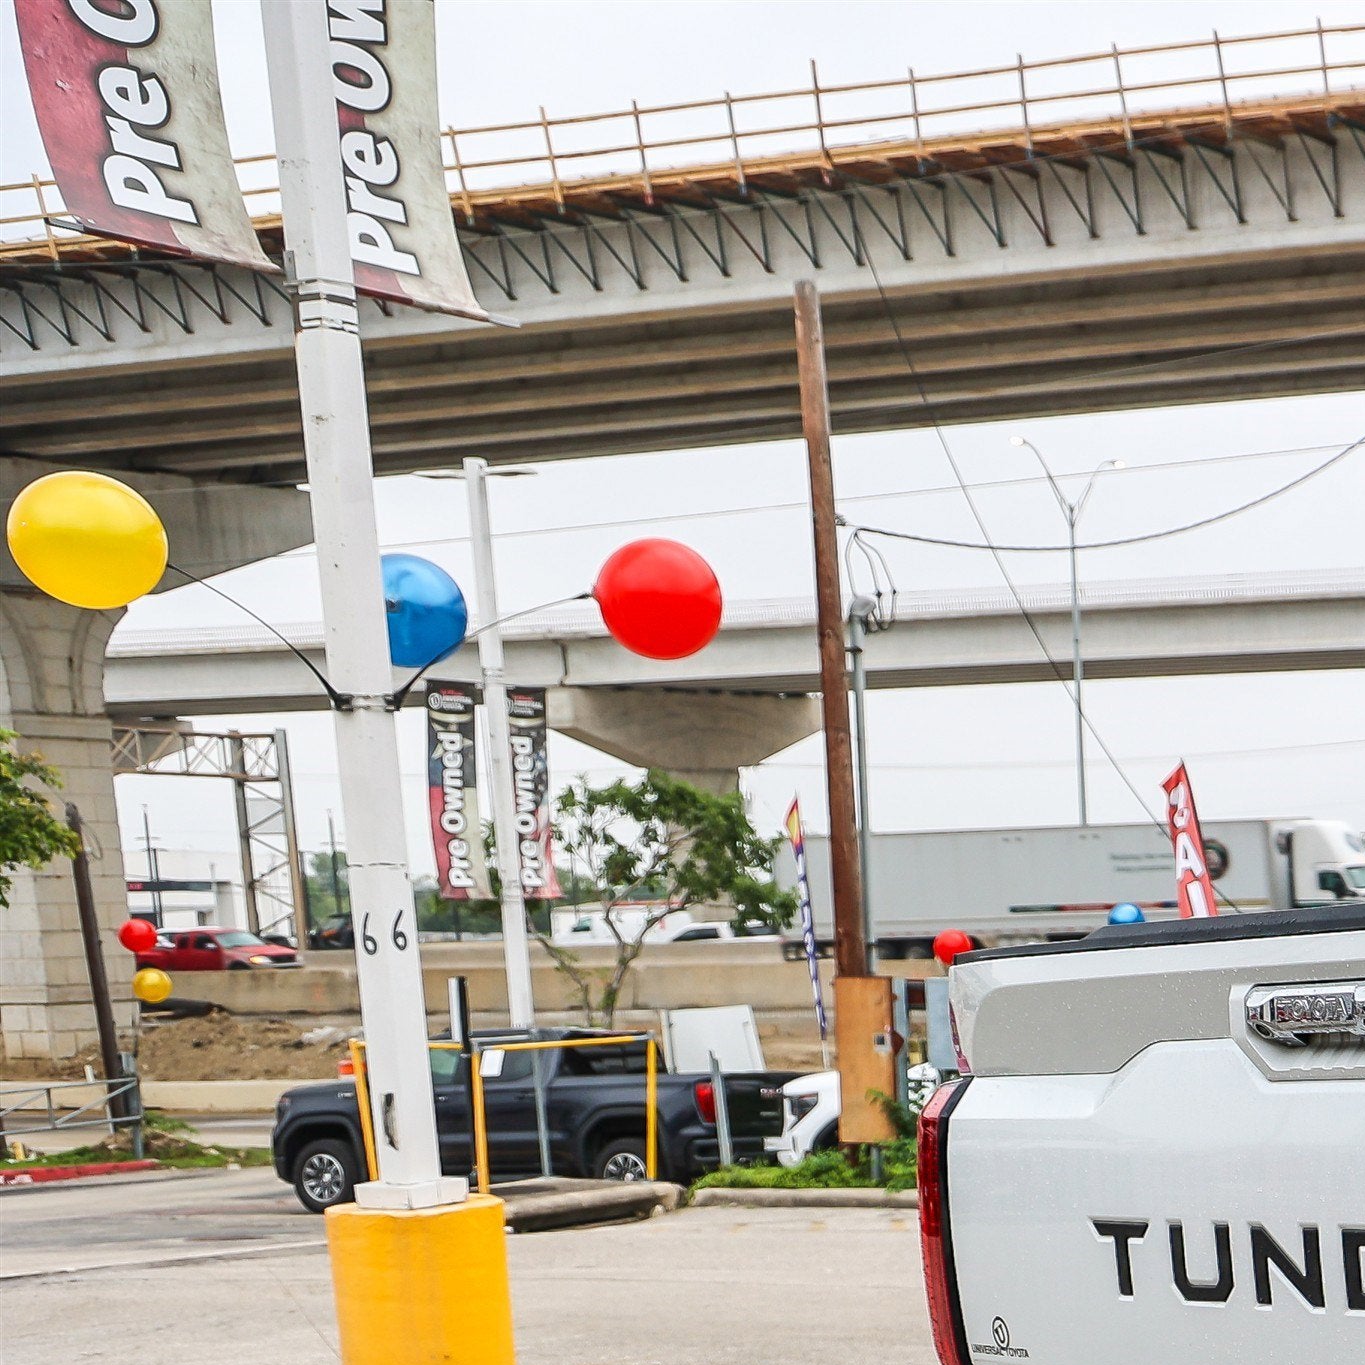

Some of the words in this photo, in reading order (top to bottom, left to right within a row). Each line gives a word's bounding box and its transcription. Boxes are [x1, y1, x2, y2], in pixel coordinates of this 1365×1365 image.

[98, 64, 202, 227] Pre
[340, 128, 422, 277] Pre
[436, 731, 467, 834] Owned
[509, 735, 538, 835] Owned
[447, 838, 477, 888] Pre
[519, 838, 545, 888] Pre
